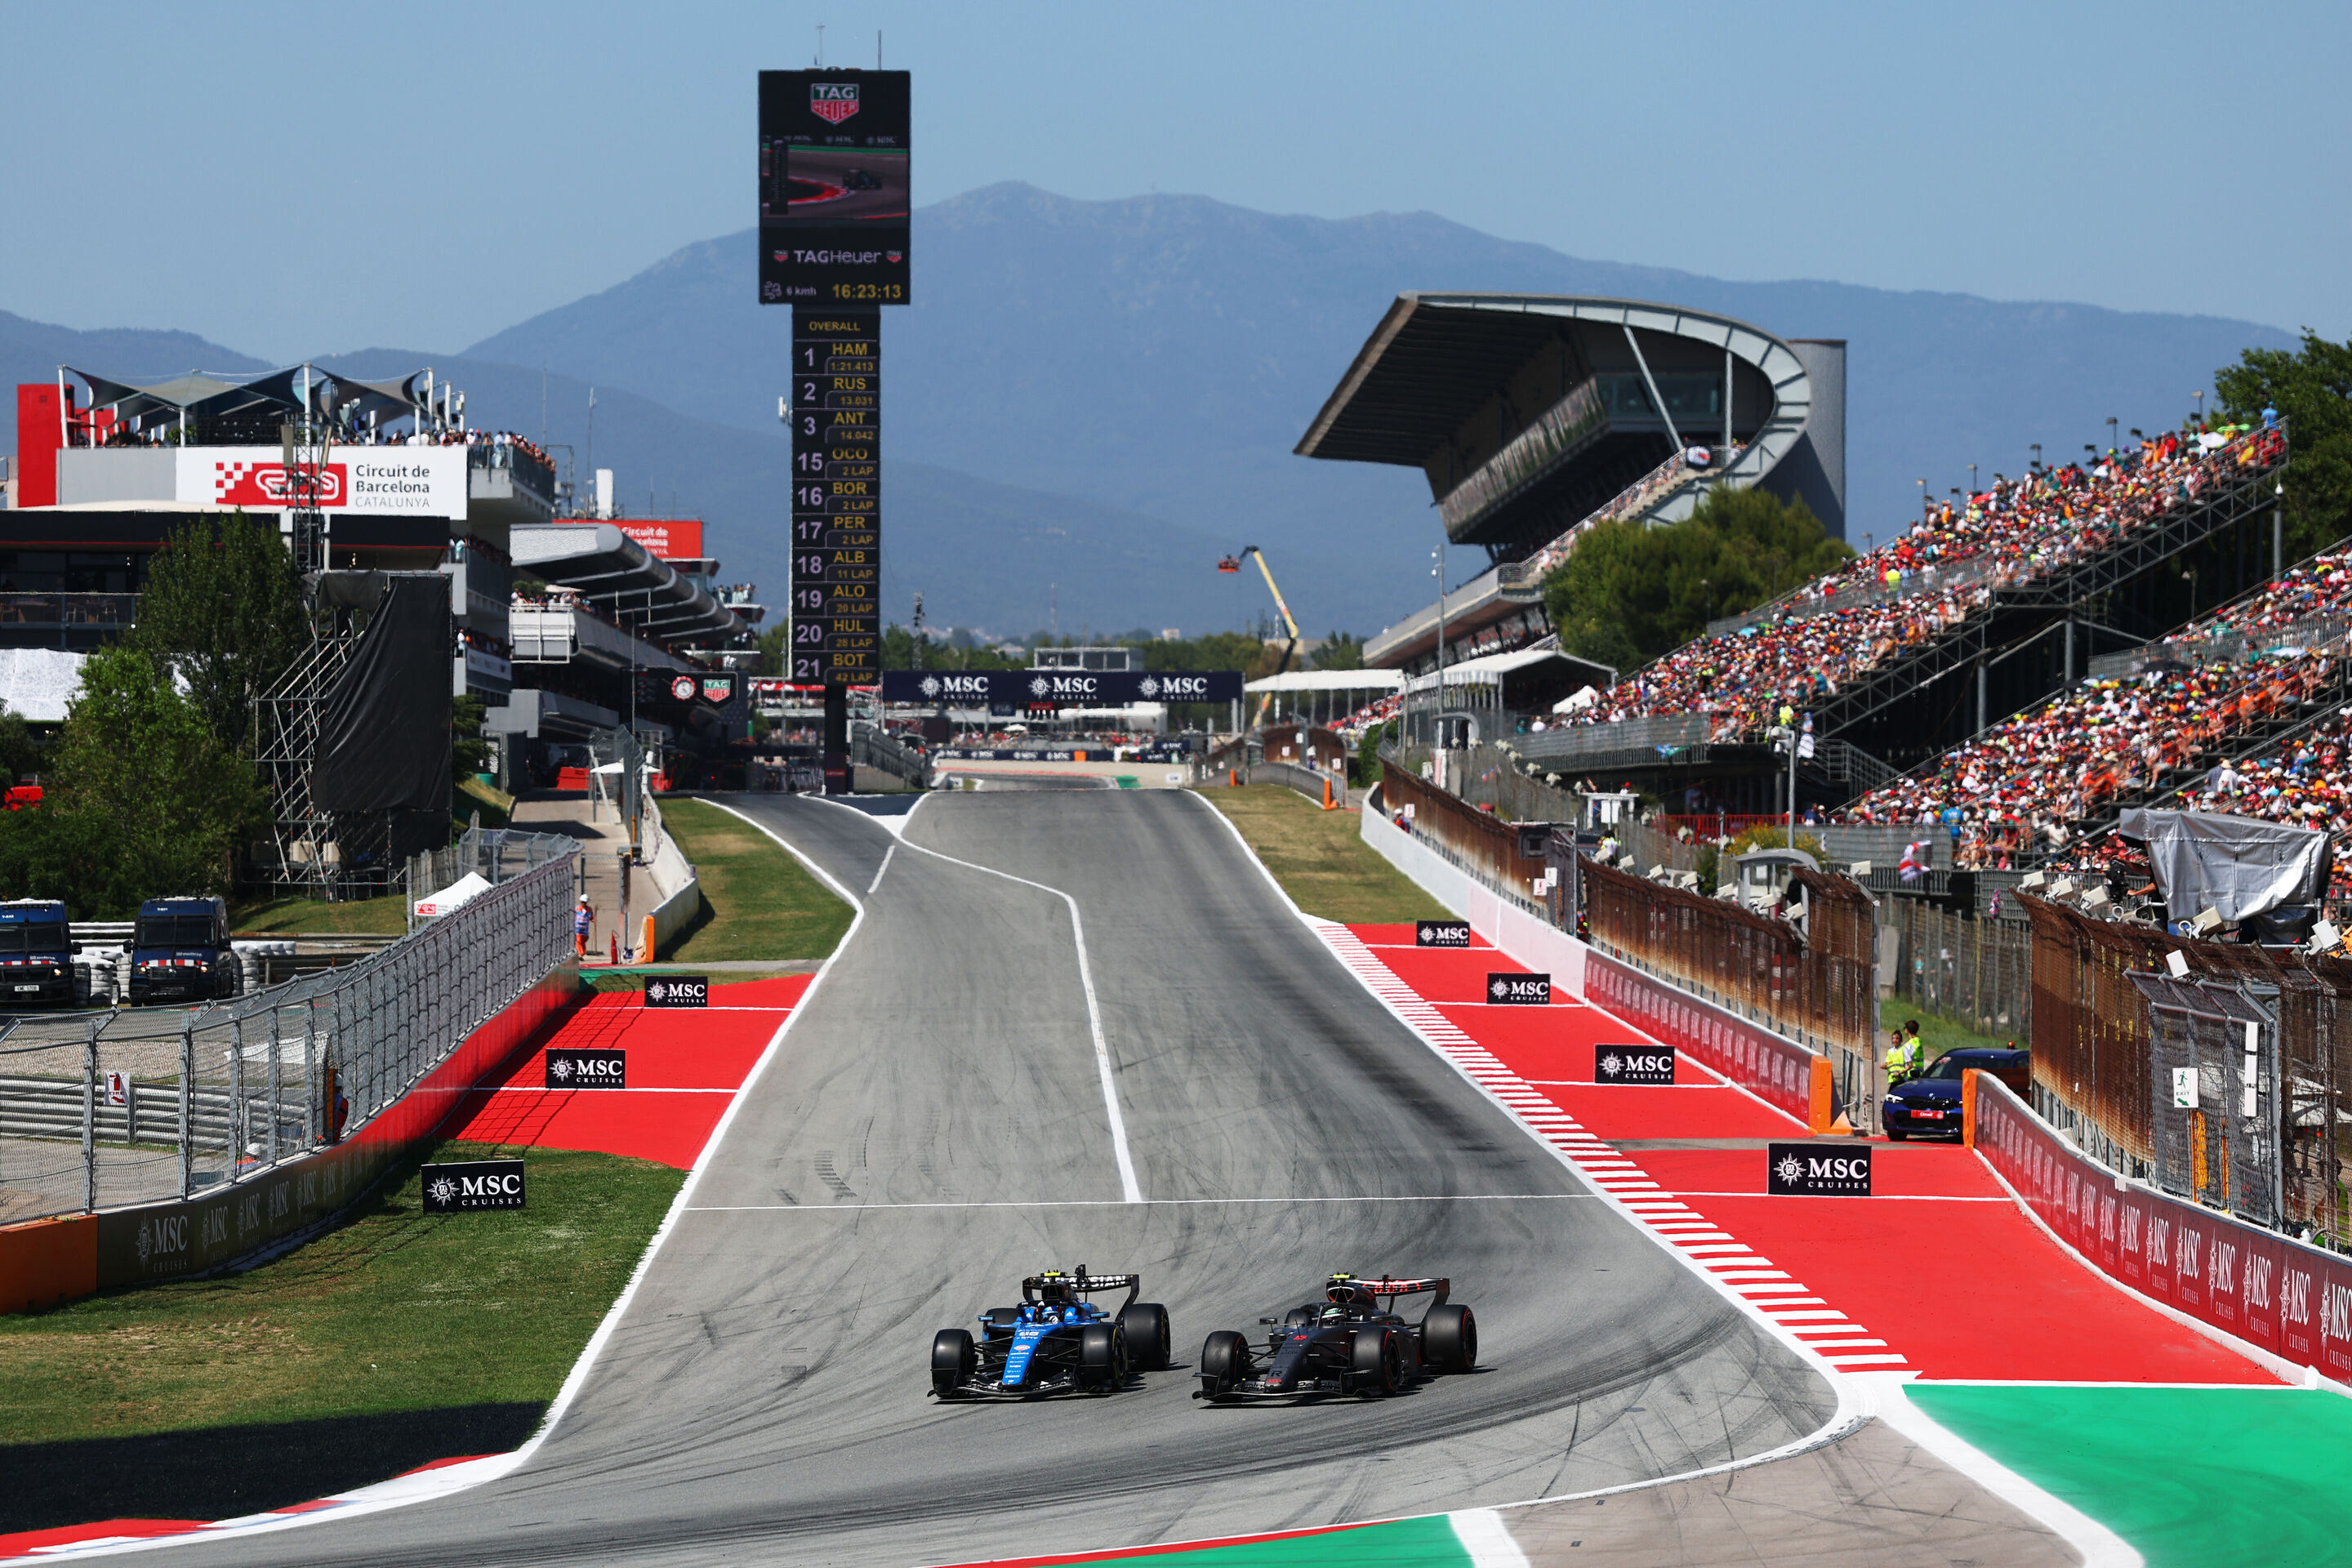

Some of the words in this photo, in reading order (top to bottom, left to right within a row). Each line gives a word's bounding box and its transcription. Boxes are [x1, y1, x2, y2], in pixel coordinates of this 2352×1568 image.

[816, 87, 854, 99] TAG
[814, 100, 857, 121] HEUER
[832, 284, 902, 299] 16:23:13
[809, 321, 861, 332] OVERALL
[805, 349, 814, 367] 1
[832, 343, 867, 356] HAM
[831, 362, 874, 372] 1:21.413
[804, 382, 816, 401] 2
[834, 377, 866, 390] RUS
[804, 417, 816, 435] 3
[834, 412, 866, 425] ANT
[798, 452, 822, 471] 15
[832, 448, 868, 461] OCO
[356, 464, 408, 477] Circuit
[412, 465, 430, 477] de
[843, 467, 849, 476] 2
[852, 467, 874, 476] LAP
[356, 480, 430, 492] Barcelona
[833, 482, 866, 495] BOR
[356, 497, 430, 507] CATALUNYA
[798, 488, 822, 506] 16
[843, 501, 849, 510] 2
[852, 501, 874, 510] LAP
[798, 521, 822, 539] 17
[834, 516, 866, 528] PER
[843, 536, 849, 544] 2
[852, 536, 873, 545] LAP
[798, 555, 822, 574] 18
[833, 551, 866, 564] ALB
[838, 570, 847, 579] 11
[852, 570, 873, 579] LAP
[797, 590, 822, 608] 19
[833, 585, 866, 598] ALO
[852, 604, 873, 613] LAP
[796, 625, 822, 643] 20
[834, 620, 866, 632] HUL
[852, 638, 873, 648] LAP
[796, 659, 820, 677] 21
[833, 654, 866, 666] BOT
[851, 673, 873, 682] LAP
[943, 676, 989, 693] MSC
[1053, 677, 1098, 694] MSC
[1163, 677, 1208, 694] MSC
[1436, 927, 1468, 939] MSC
[668, 983, 705, 997] MSC
[1511, 982, 1549, 996] MSC
[577, 1059, 622, 1076] MSC
[1625, 1055, 1672, 1071] MSC
[1807, 1158, 1868, 1179] MSC
[461, 1174, 520, 1196] MSC
[1807, 1181, 1868, 1189] CRUISES
[461, 1197, 521, 1206] CRUISES
[246, 1193, 260, 1231] MSC
[210, 1206, 228, 1244] MSC
[2126, 1205, 2140, 1254] MSC
[154, 1215, 188, 1254] MSC
[2153, 1216, 2169, 1267] MSC
[2183, 1227, 2201, 1280] MSC
[154, 1260, 188, 1272] CRUISES
[2216, 1241, 2235, 1294] MSC
[2152, 1274, 2167, 1292] CRUISES
[2251, 1254, 2271, 1310] MSC
[2182, 1286, 2198, 1305] CRUISES
[2290, 1269, 2310, 1326] MSC
[2216, 1301, 2234, 1321] CRUISES
[2330, 1283, 2352, 1343] MSC
[2251, 1316, 2270, 1337] CRUISES
[2289, 1333, 2309, 1353] CRUISES
[2329, 1349, 2351, 1371] CRUISES
